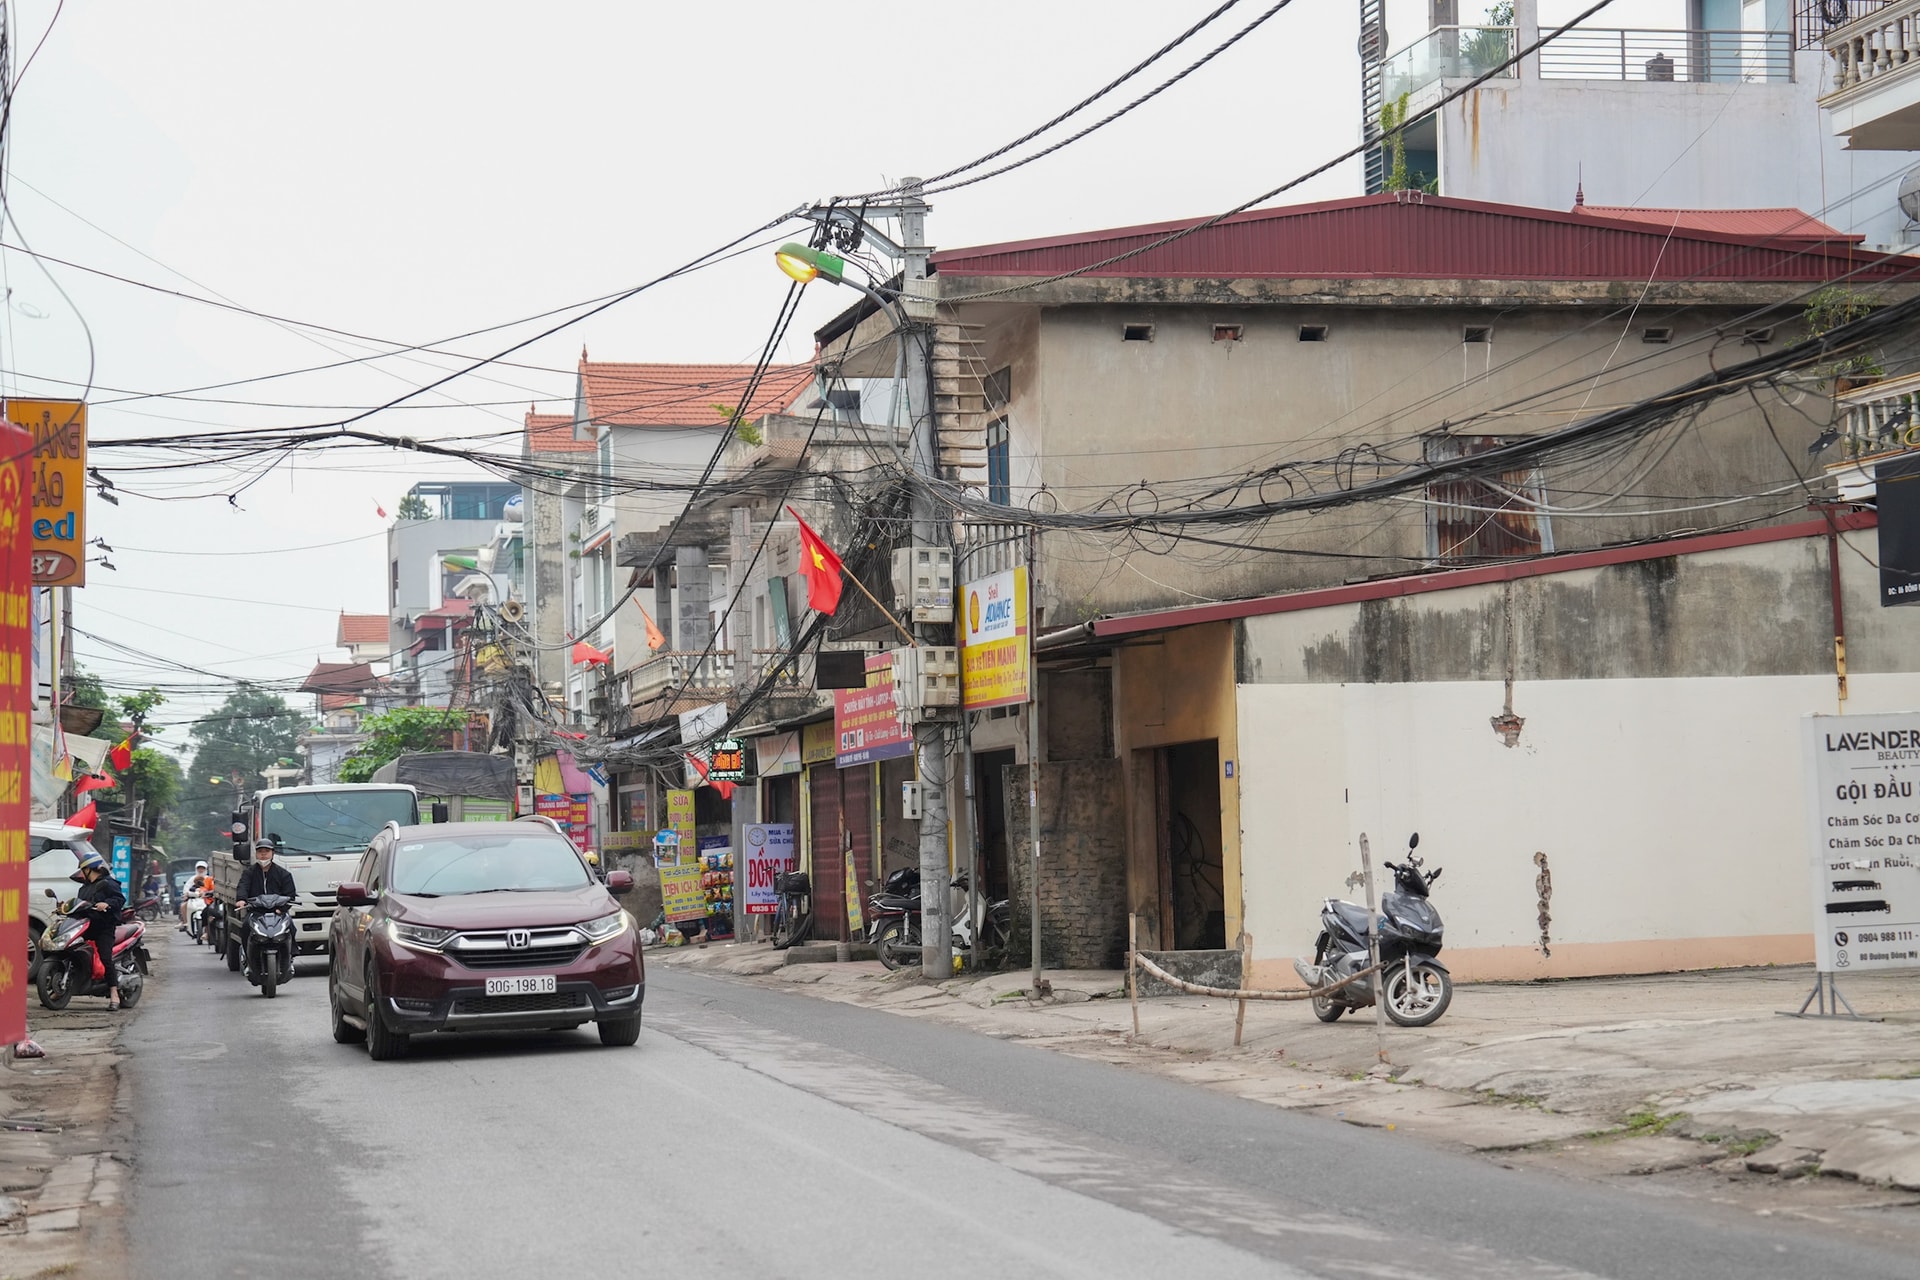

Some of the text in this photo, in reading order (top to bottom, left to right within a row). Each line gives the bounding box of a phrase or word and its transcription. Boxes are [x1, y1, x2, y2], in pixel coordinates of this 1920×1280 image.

[14, 411, 81, 459] UẢNG
[988, 583, 999, 600] Shell
[984, 599, 1011, 623] ADVANCE
[1826, 730, 1920, 752] LAVENDER
[1877, 750, 1920, 761] BEAUTY
[1836, 774, 1912, 805] GỘI ĐẦU
[1827, 816, 1859, 827] Chăm
[1863, 814, 1883, 825] Sóc
[1887, 814, 1901, 824] Da
[1828, 838, 1860, 848] Chăm
[1864, 836, 1884, 847] Sóc
[1888, 836, 1903, 846] Da
[1858, 931, 1912, 943] 0904 988 111
[488, 978, 554, 993] 30G-198.18
